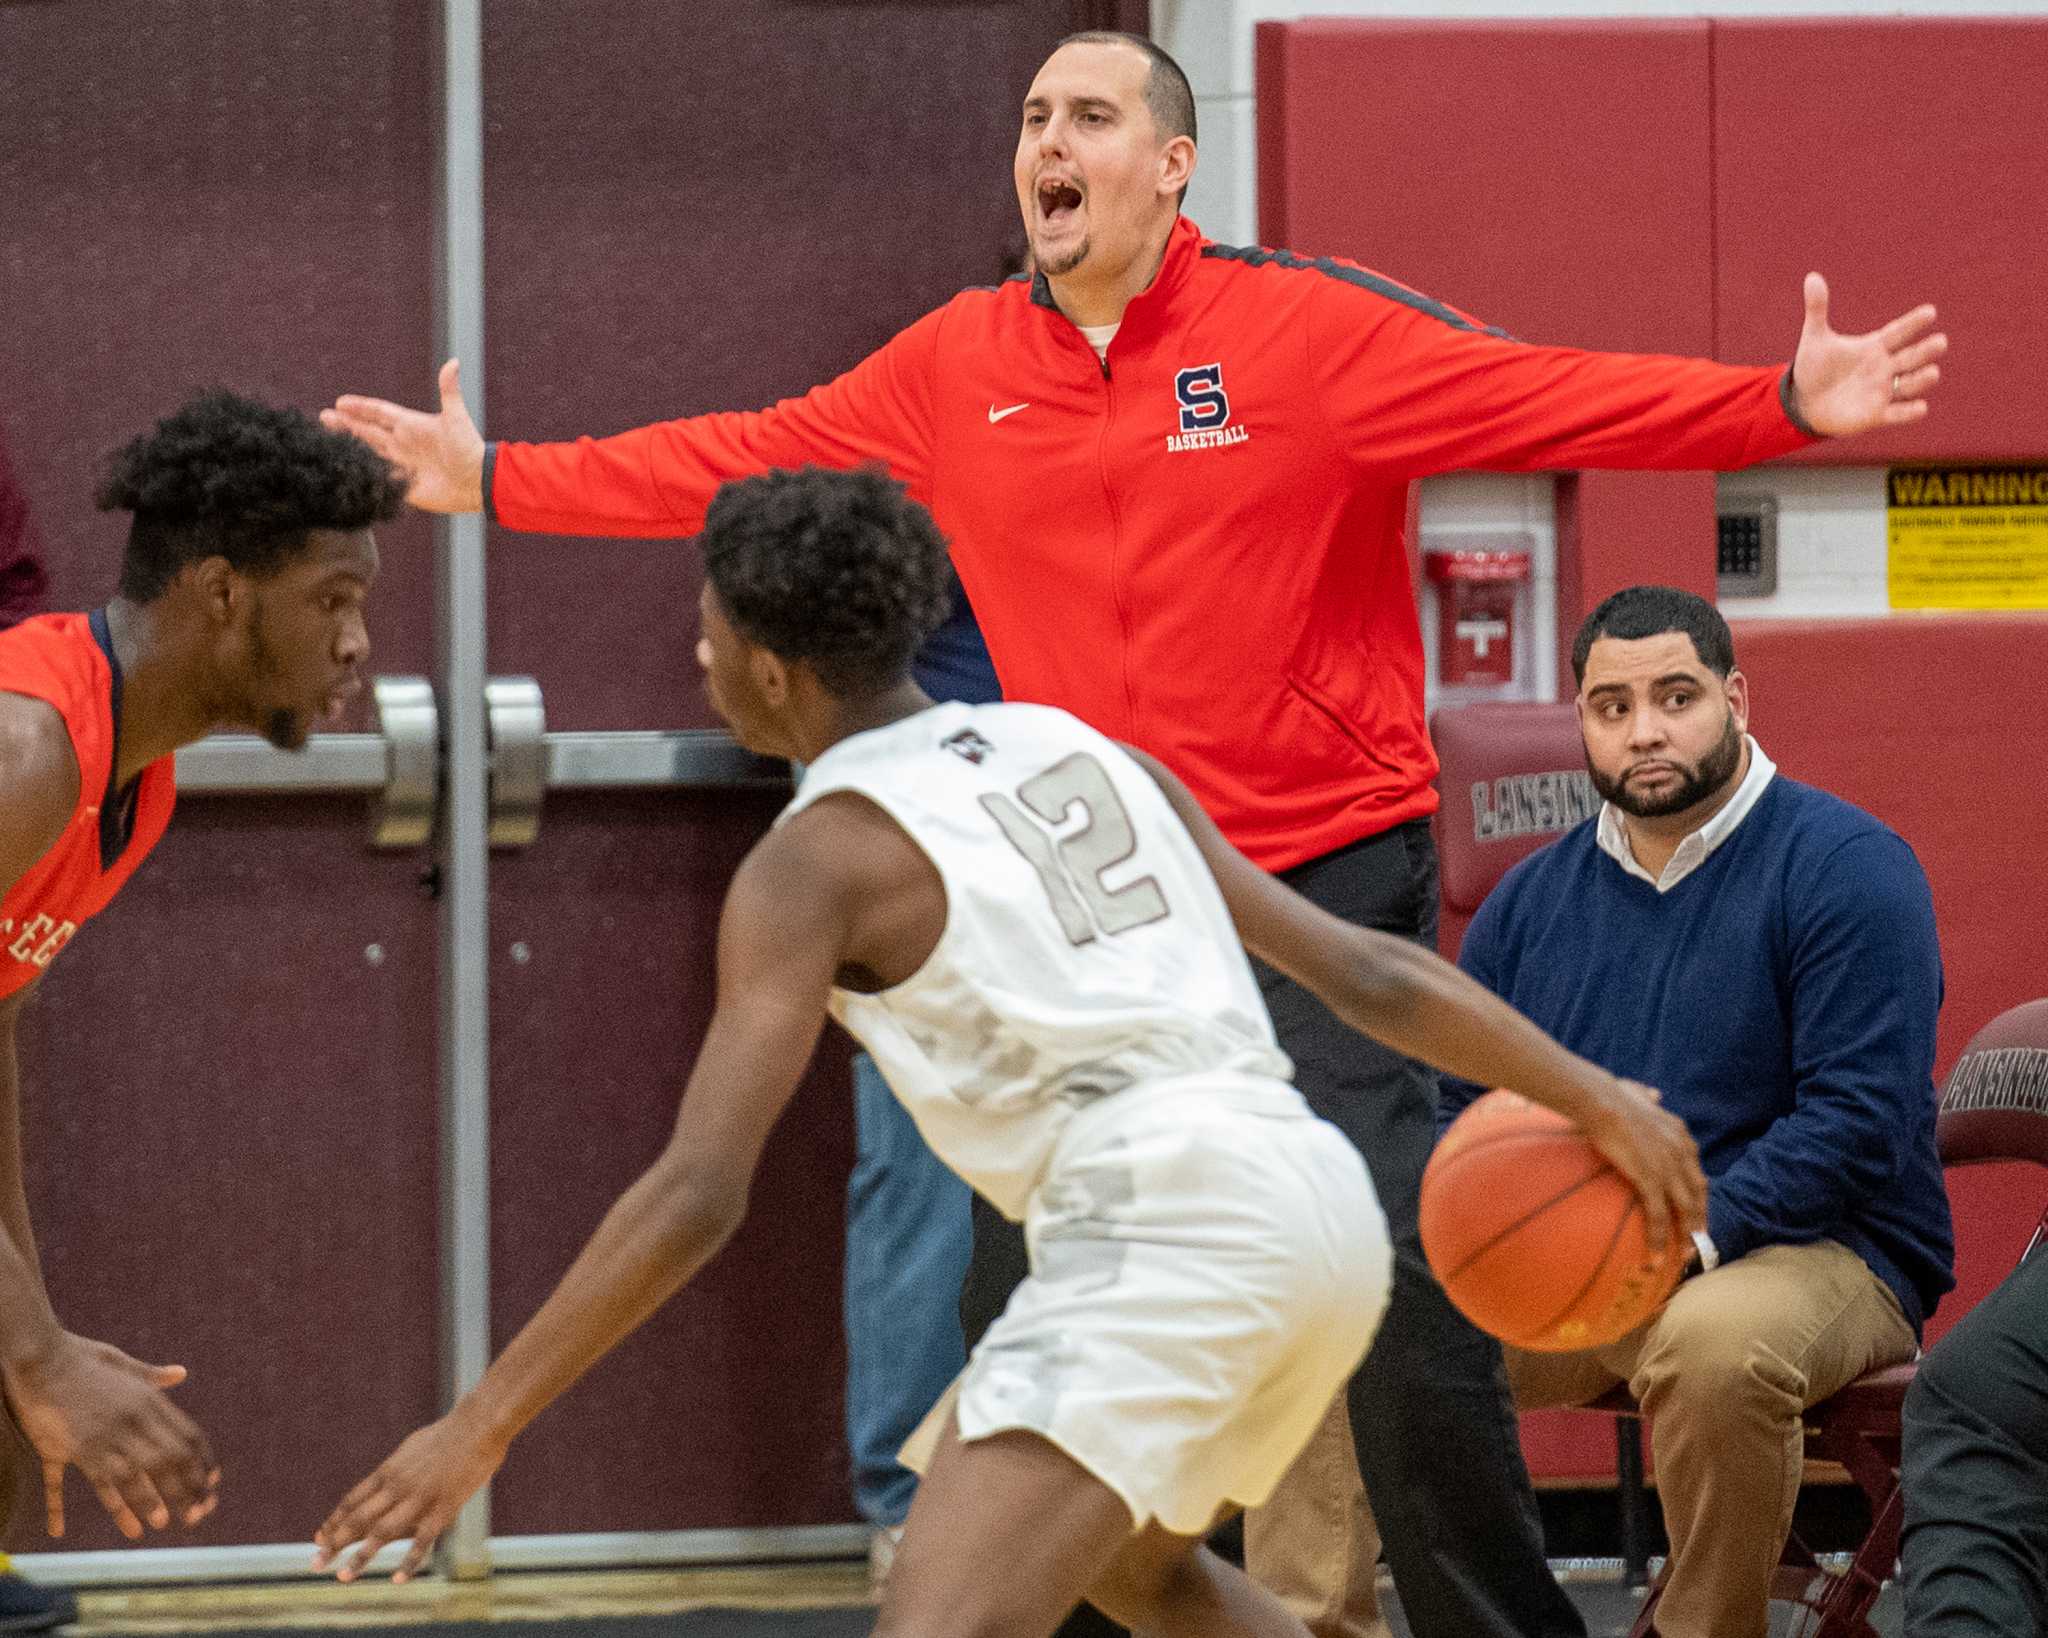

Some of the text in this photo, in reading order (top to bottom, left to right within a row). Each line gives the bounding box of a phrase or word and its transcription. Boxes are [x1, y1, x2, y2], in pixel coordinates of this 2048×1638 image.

[1174, 362, 1231, 433] S
[1166, 424, 1249, 453] BASKETBALL
[976, 751, 1171, 948] 12
[0, 912, 76, 968] EE
